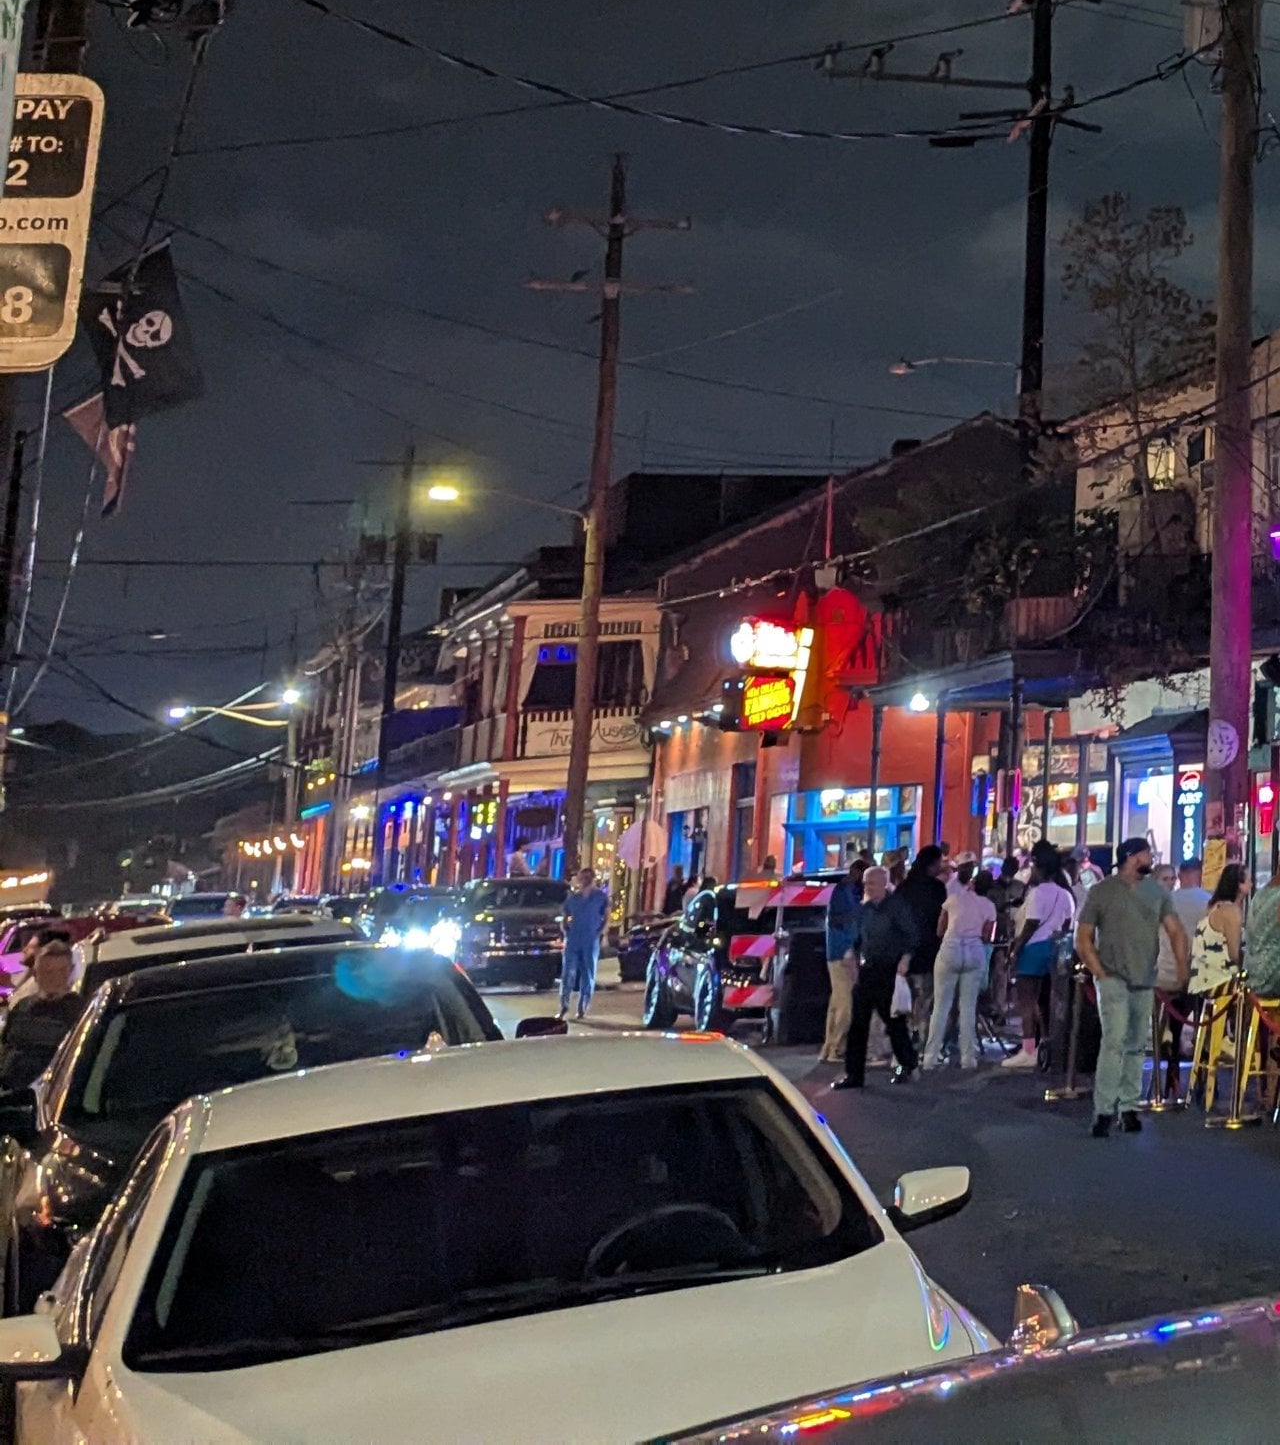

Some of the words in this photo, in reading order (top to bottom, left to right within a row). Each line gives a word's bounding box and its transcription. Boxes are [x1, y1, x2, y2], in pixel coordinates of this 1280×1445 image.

[15, 99, 75, 120] PAY
[27, 135, 64, 153] TO:
[5, 158, 29, 186] 2
[4, 284, 33, 324] 8
[537, 728, 576, 748] Thr
